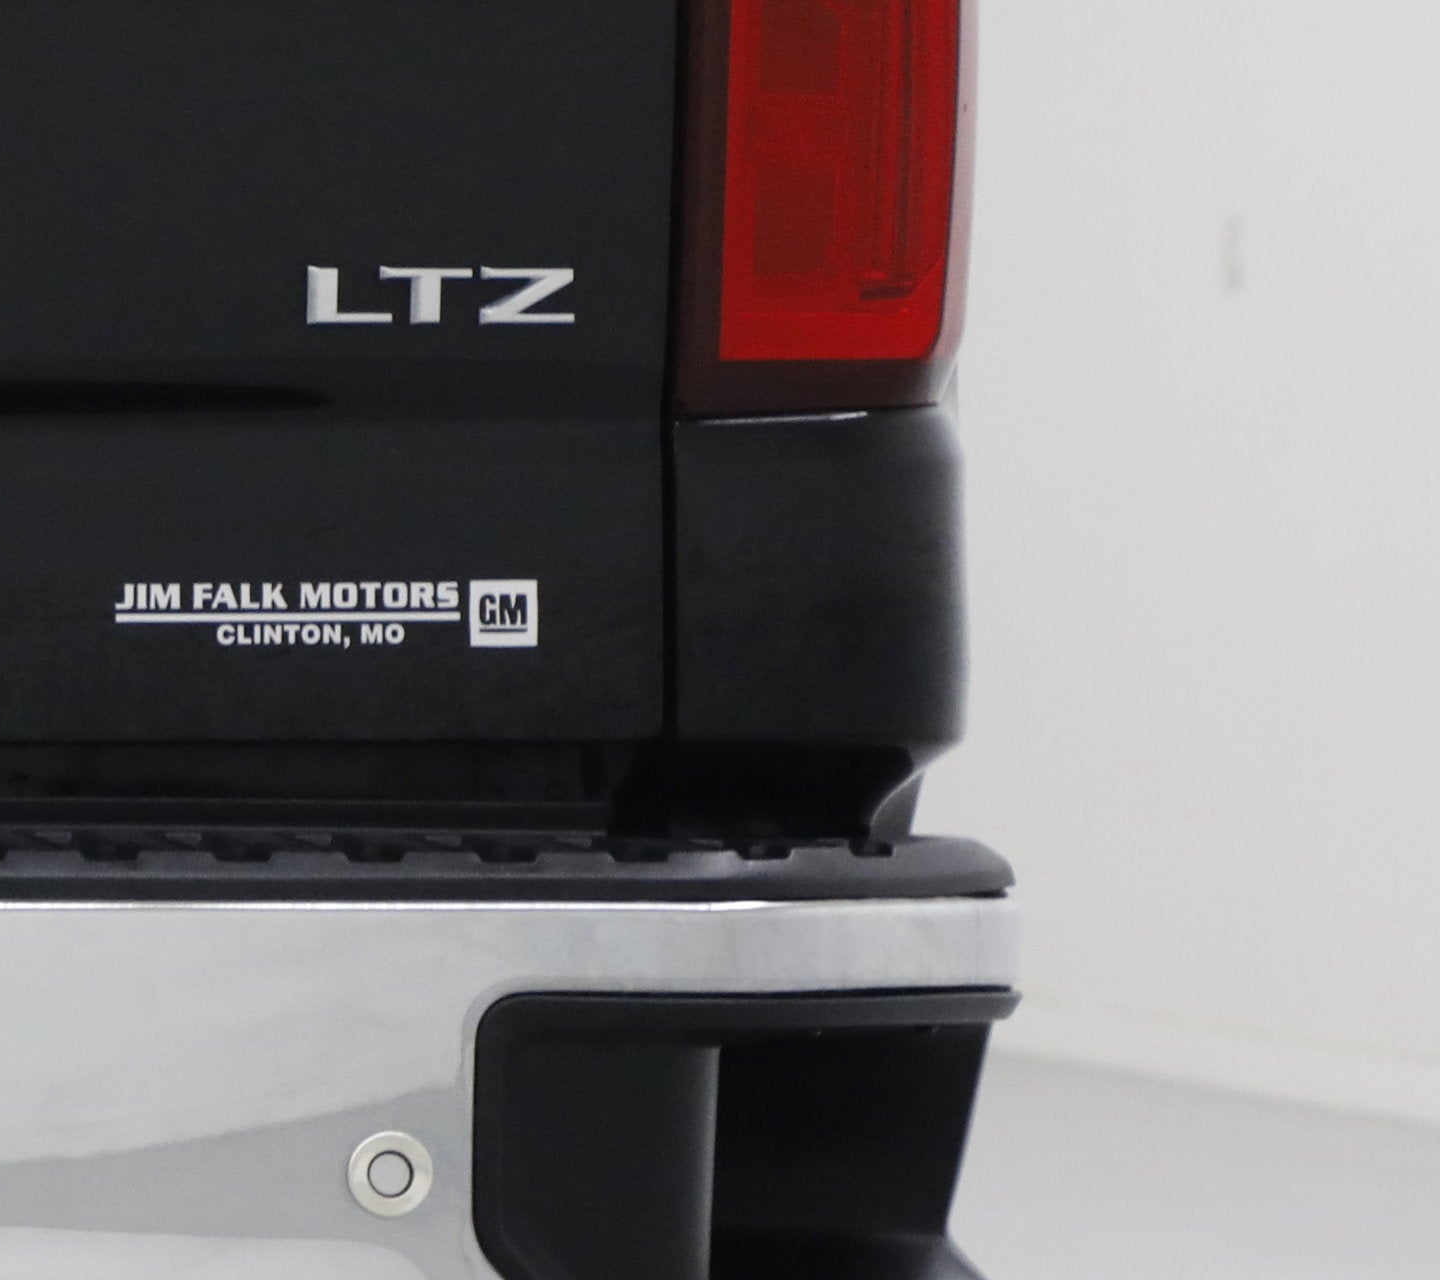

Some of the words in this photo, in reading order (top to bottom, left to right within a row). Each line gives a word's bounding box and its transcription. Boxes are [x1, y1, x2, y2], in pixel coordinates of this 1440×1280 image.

[306, 265, 576, 325] LTZ
[114, 582, 182, 612] JIM
[192, 582, 289, 612] FALK
[299, 581, 461, 611] MOTORS
[479, 593, 528, 626] GM
[216, 623, 352, 650] CLINTON,
[360, 623, 407, 647] MO
